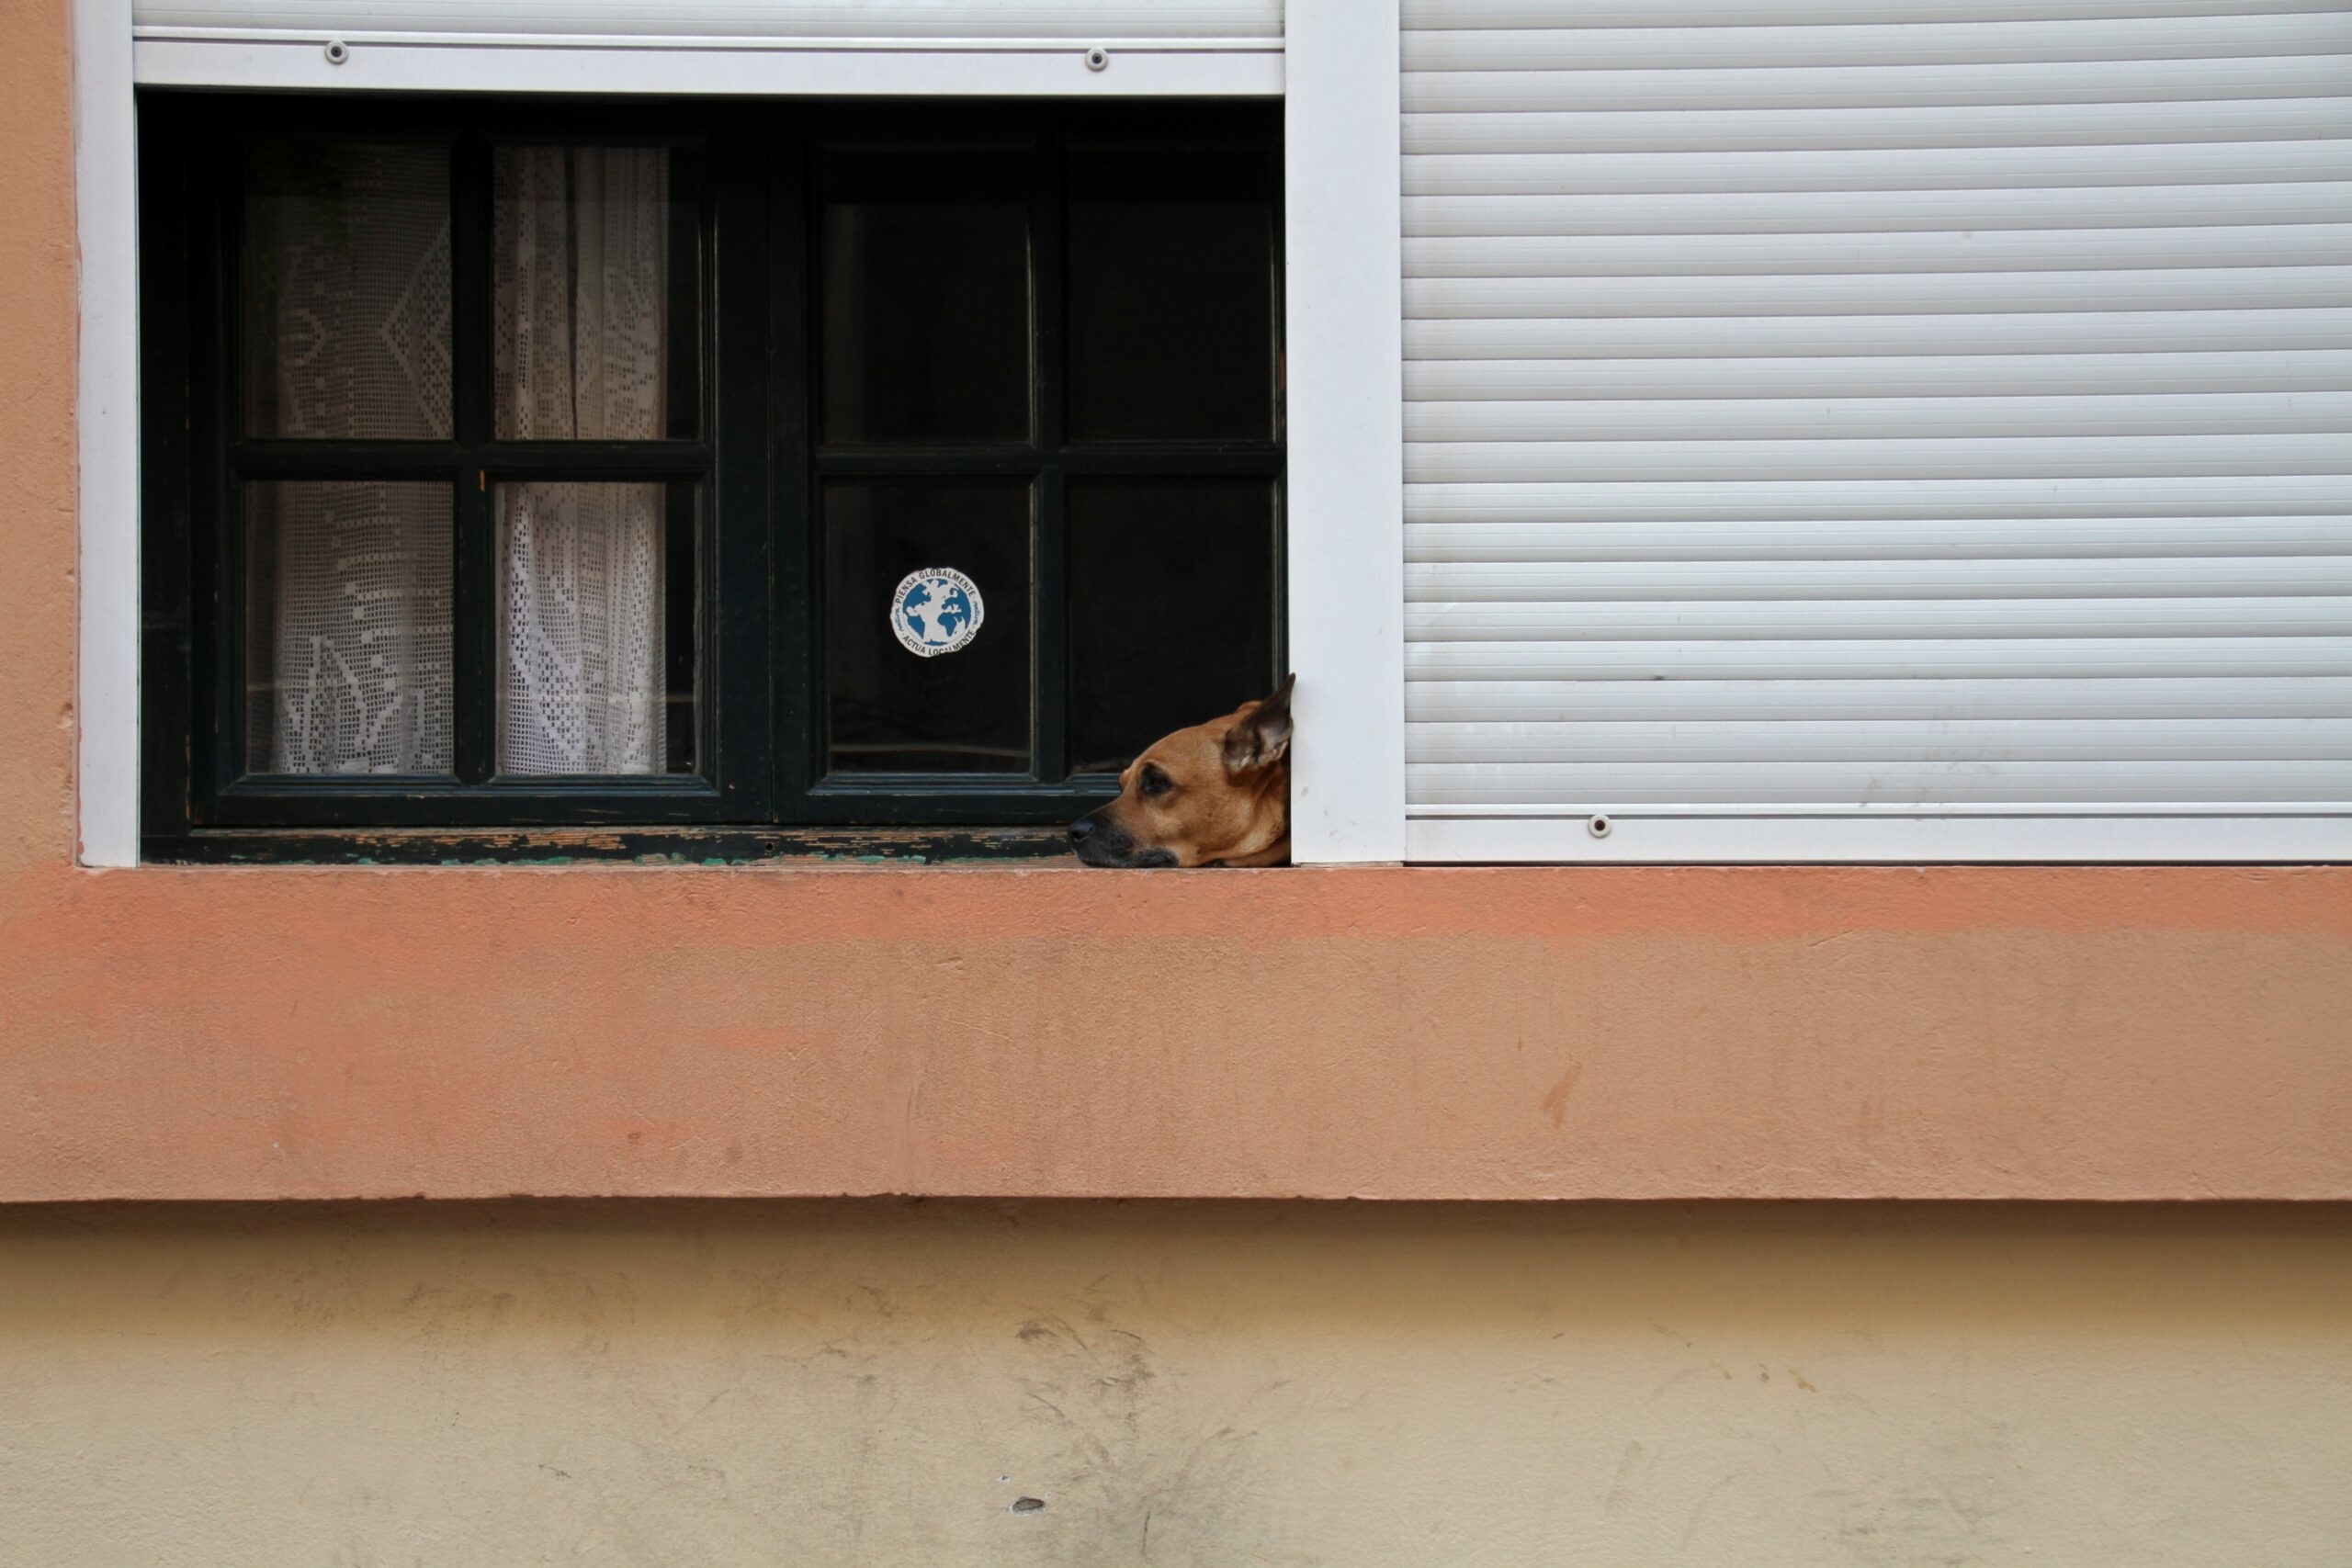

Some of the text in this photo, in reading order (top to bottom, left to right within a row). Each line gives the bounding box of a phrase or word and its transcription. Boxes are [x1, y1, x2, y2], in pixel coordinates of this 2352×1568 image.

[895, 570, 977, 604] PIENSA GLOBALMENTE
[902, 635, 926, 655] ACTUA
